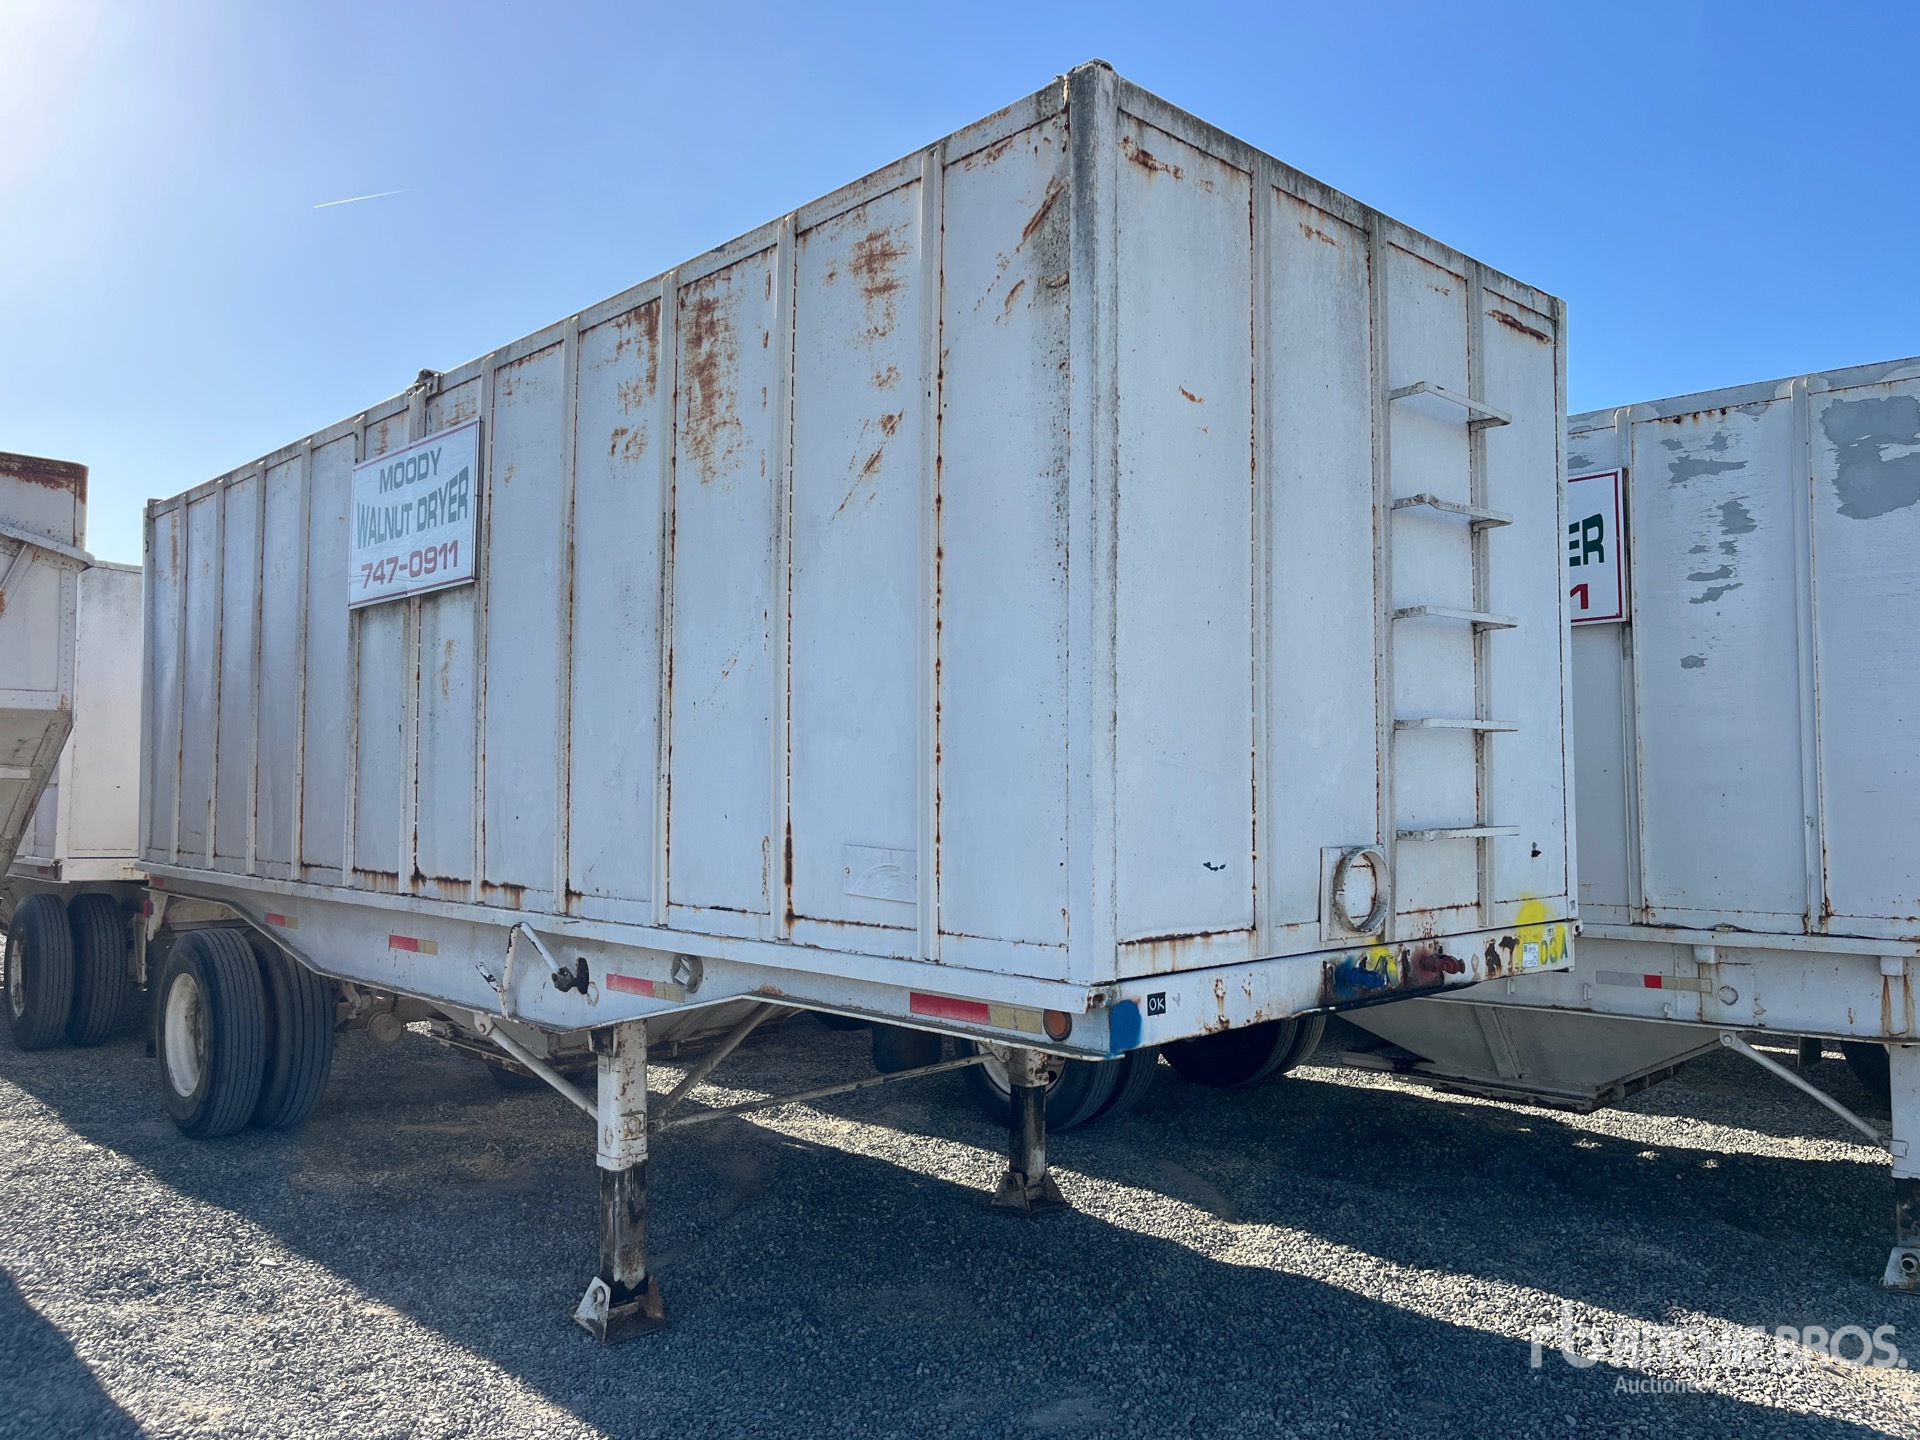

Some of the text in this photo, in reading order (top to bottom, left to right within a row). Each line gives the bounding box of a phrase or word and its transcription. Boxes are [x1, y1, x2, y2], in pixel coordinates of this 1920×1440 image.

[379, 447, 442, 494] MOODY
[357, 465, 469, 549] WALNUT DRYER
[361, 539, 459, 589] 747-0911
[1149, 997, 1165, 1011] OK
